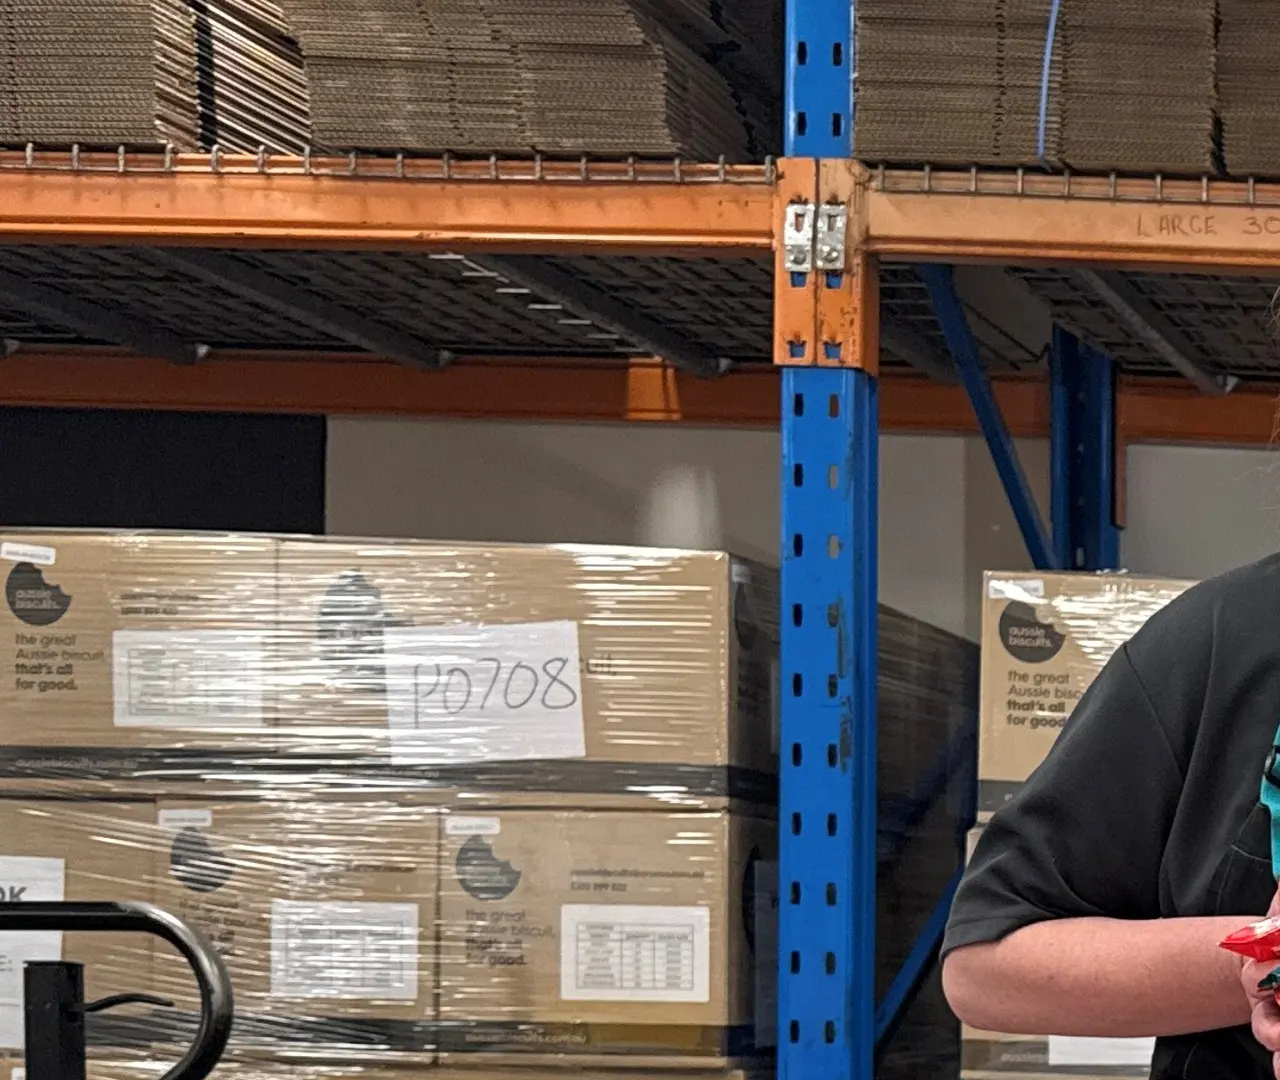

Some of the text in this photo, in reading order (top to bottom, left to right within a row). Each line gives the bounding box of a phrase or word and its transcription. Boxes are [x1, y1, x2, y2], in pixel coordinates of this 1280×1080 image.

[1136, 213, 1218, 237] LARGE
[1008, 670, 1070, 686] the great
[1008, 685, 1084, 700] Aussie bisc
[1007, 699, 1065, 712] that's all
[1007, 714, 1068, 729] for good
